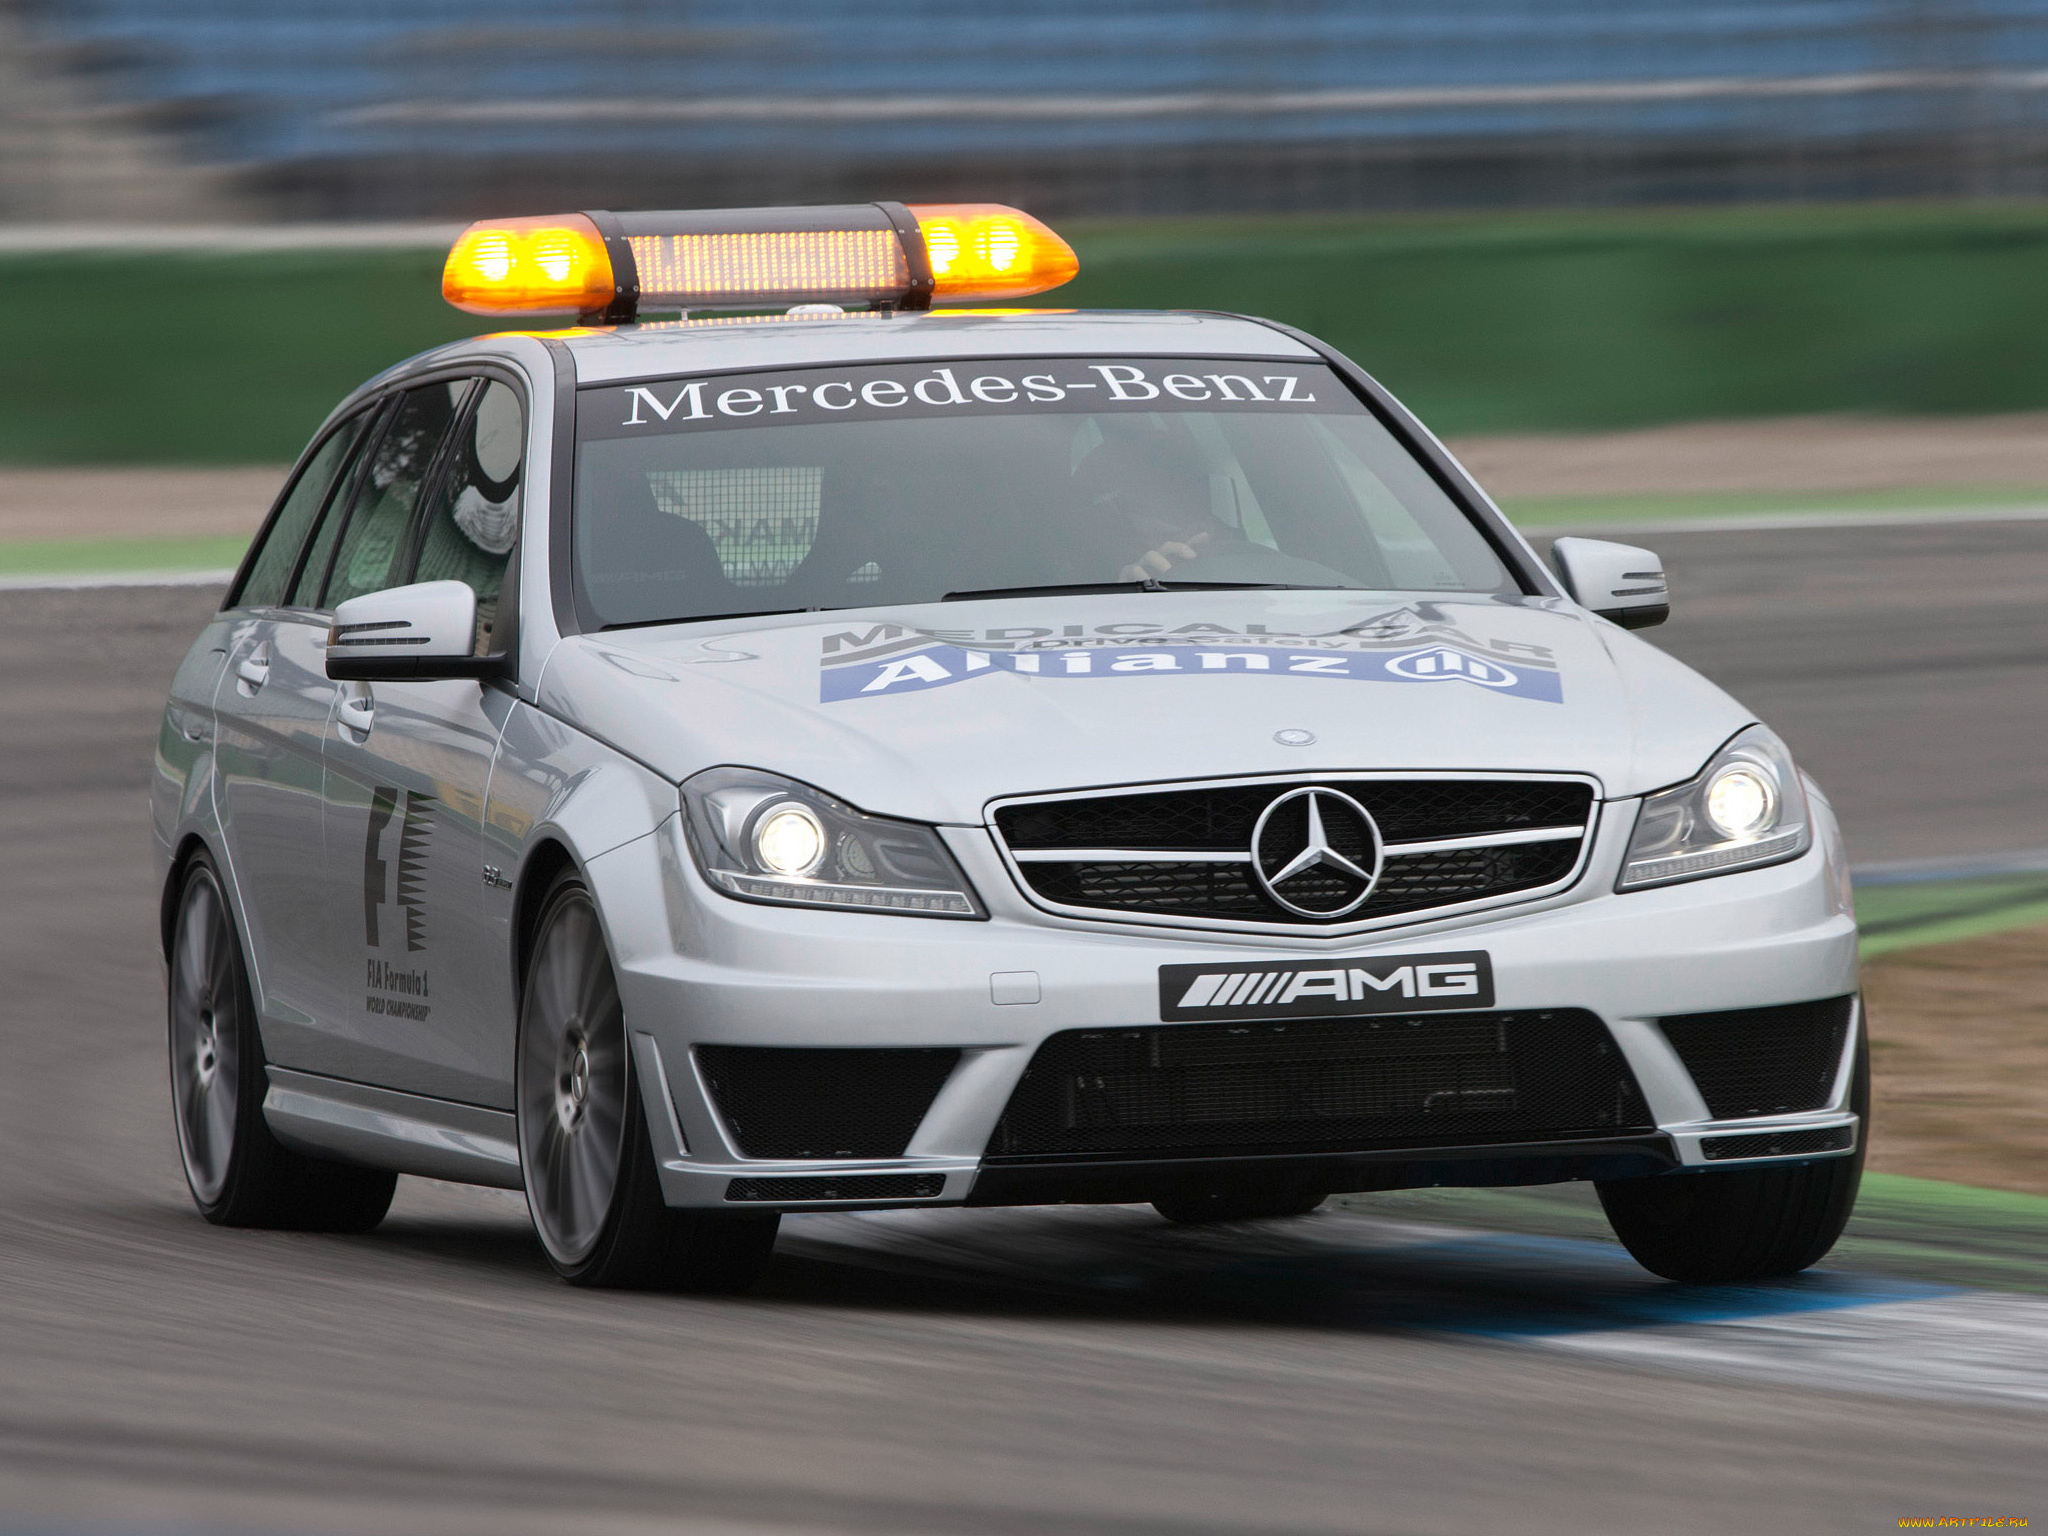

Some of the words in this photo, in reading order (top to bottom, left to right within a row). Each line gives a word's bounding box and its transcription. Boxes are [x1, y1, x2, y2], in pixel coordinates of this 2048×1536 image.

[621, 364, 1317, 426] Mercedes-Benz
[822, 622, 1302, 654] MEDICAL
[860, 650, 1350, 693] Allianz
[367, 958, 383, 989] FIA
[384, 961, 421, 996] Formula
[422, 969, 429, 997] 1
[366, 995, 385, 1015] WORLD
